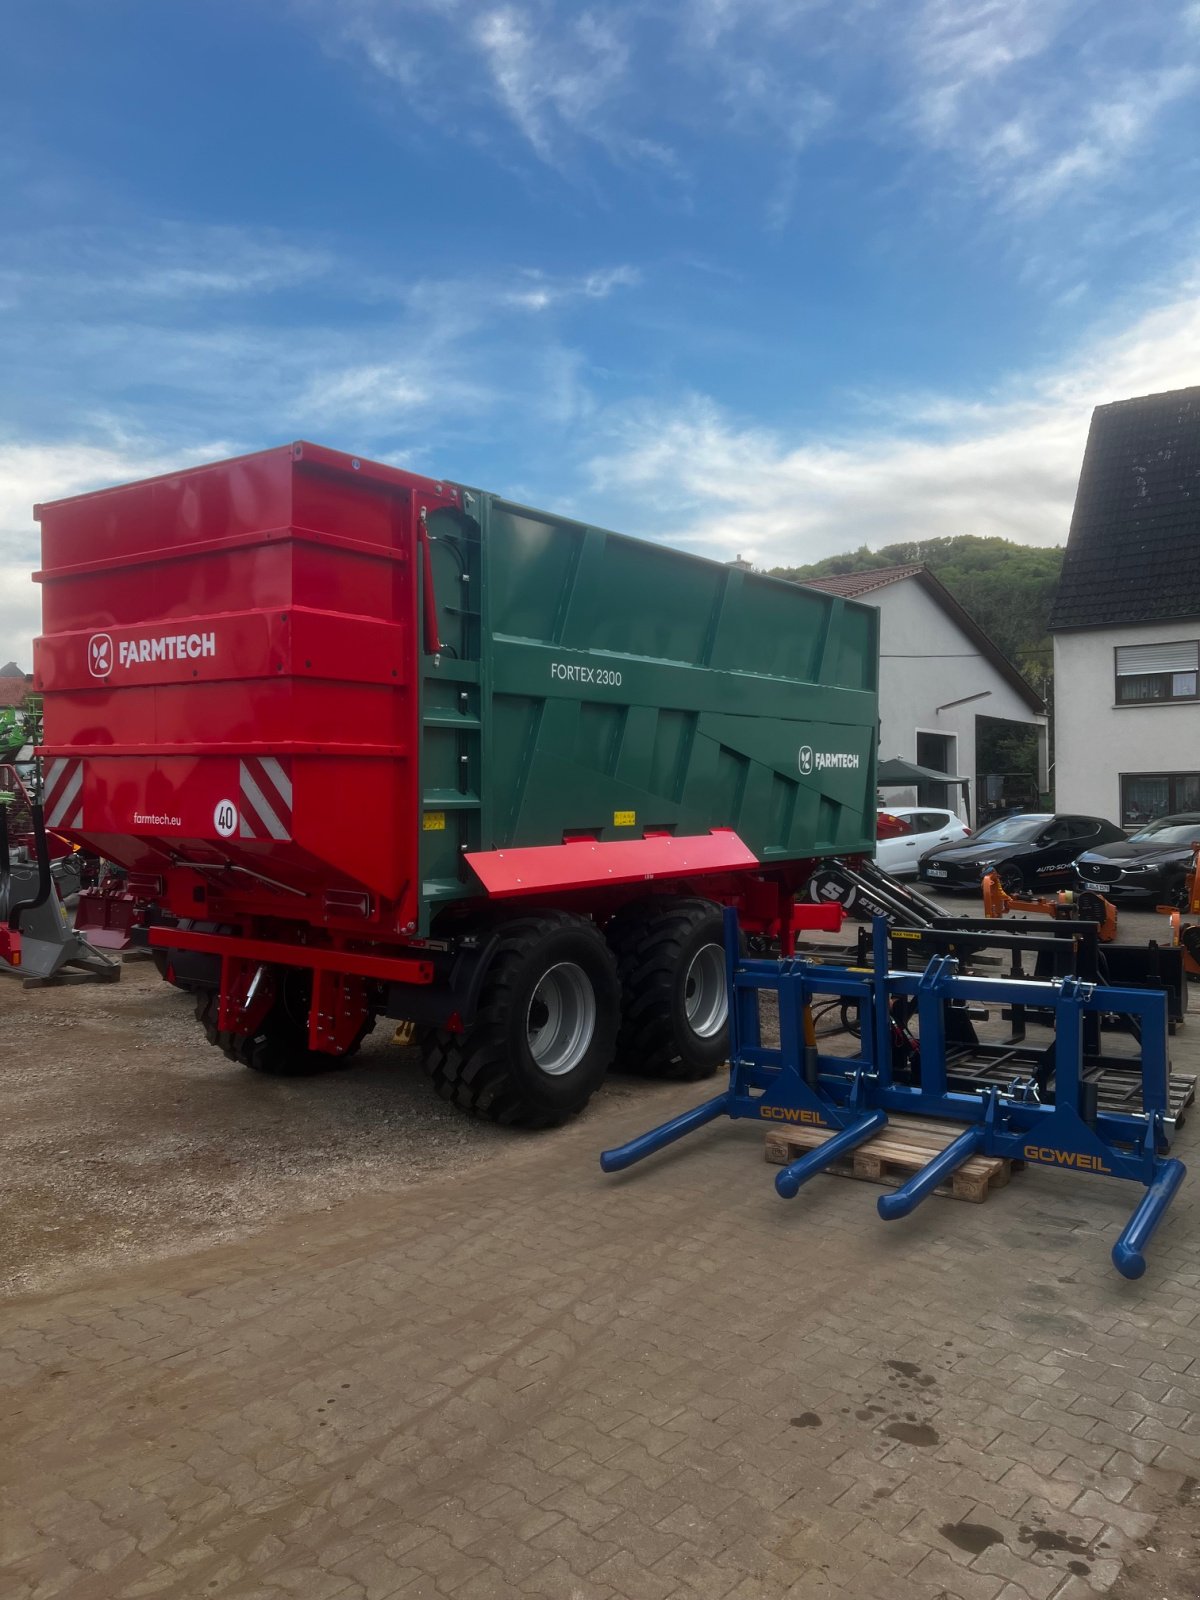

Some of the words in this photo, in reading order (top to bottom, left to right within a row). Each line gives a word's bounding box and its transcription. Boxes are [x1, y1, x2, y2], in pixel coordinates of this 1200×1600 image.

[119, 632, 215, 669] FARMTECH
[551, 663, 595, 683] FORTEX
[596, 669, 622, 687] 2300
[815, 752, 860, 771] FARMTECH
[133, 812, 182, 826] farmtech.eu
[218, 806, 233, 830] 40
